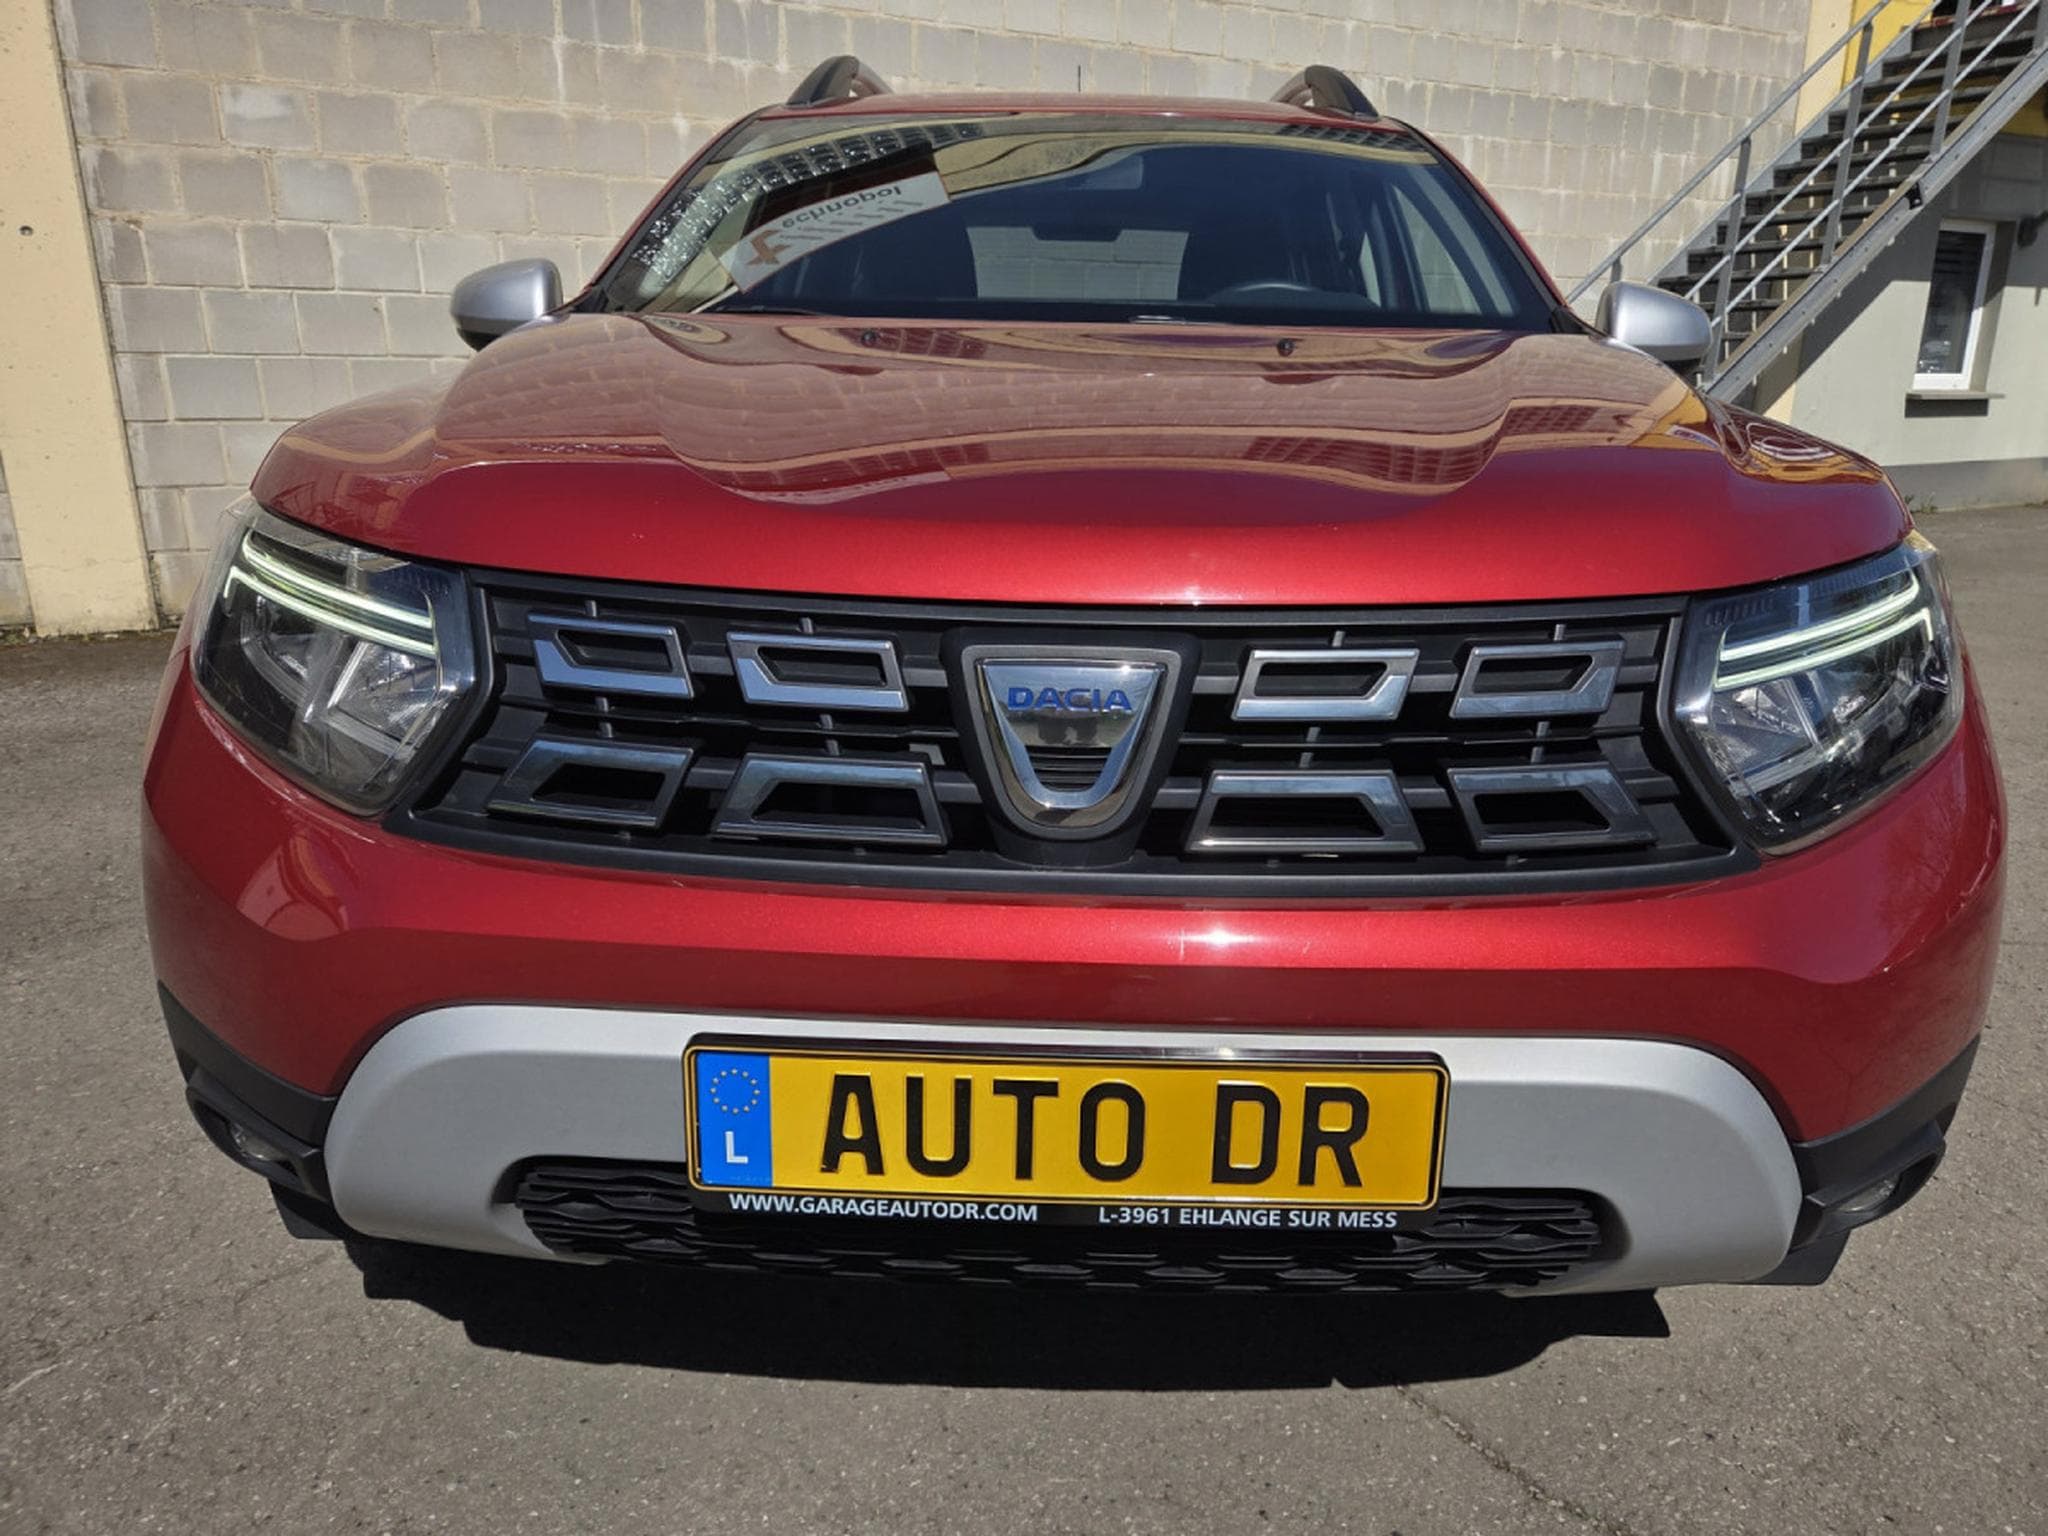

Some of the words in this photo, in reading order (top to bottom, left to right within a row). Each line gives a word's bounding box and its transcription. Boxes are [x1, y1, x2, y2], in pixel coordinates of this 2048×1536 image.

[1007, 687, 1132, 712] DACIA
[820, 1073, 1145, 1182] AUTO
[1211, 1081, 1370, 1188] DR
[725, 1131, 748, 1164] L
[729, 1192, 1038, 1222] WWW.GARAGEAUTODR.COM
[1098, 1207, 1170, 1224] L-3961
[1179, 1209, 1281, 1227] EHLANGE
[1288, 1212, 1331, 1227] SUR
[1338, 1212, 1398, 1229] MESS
